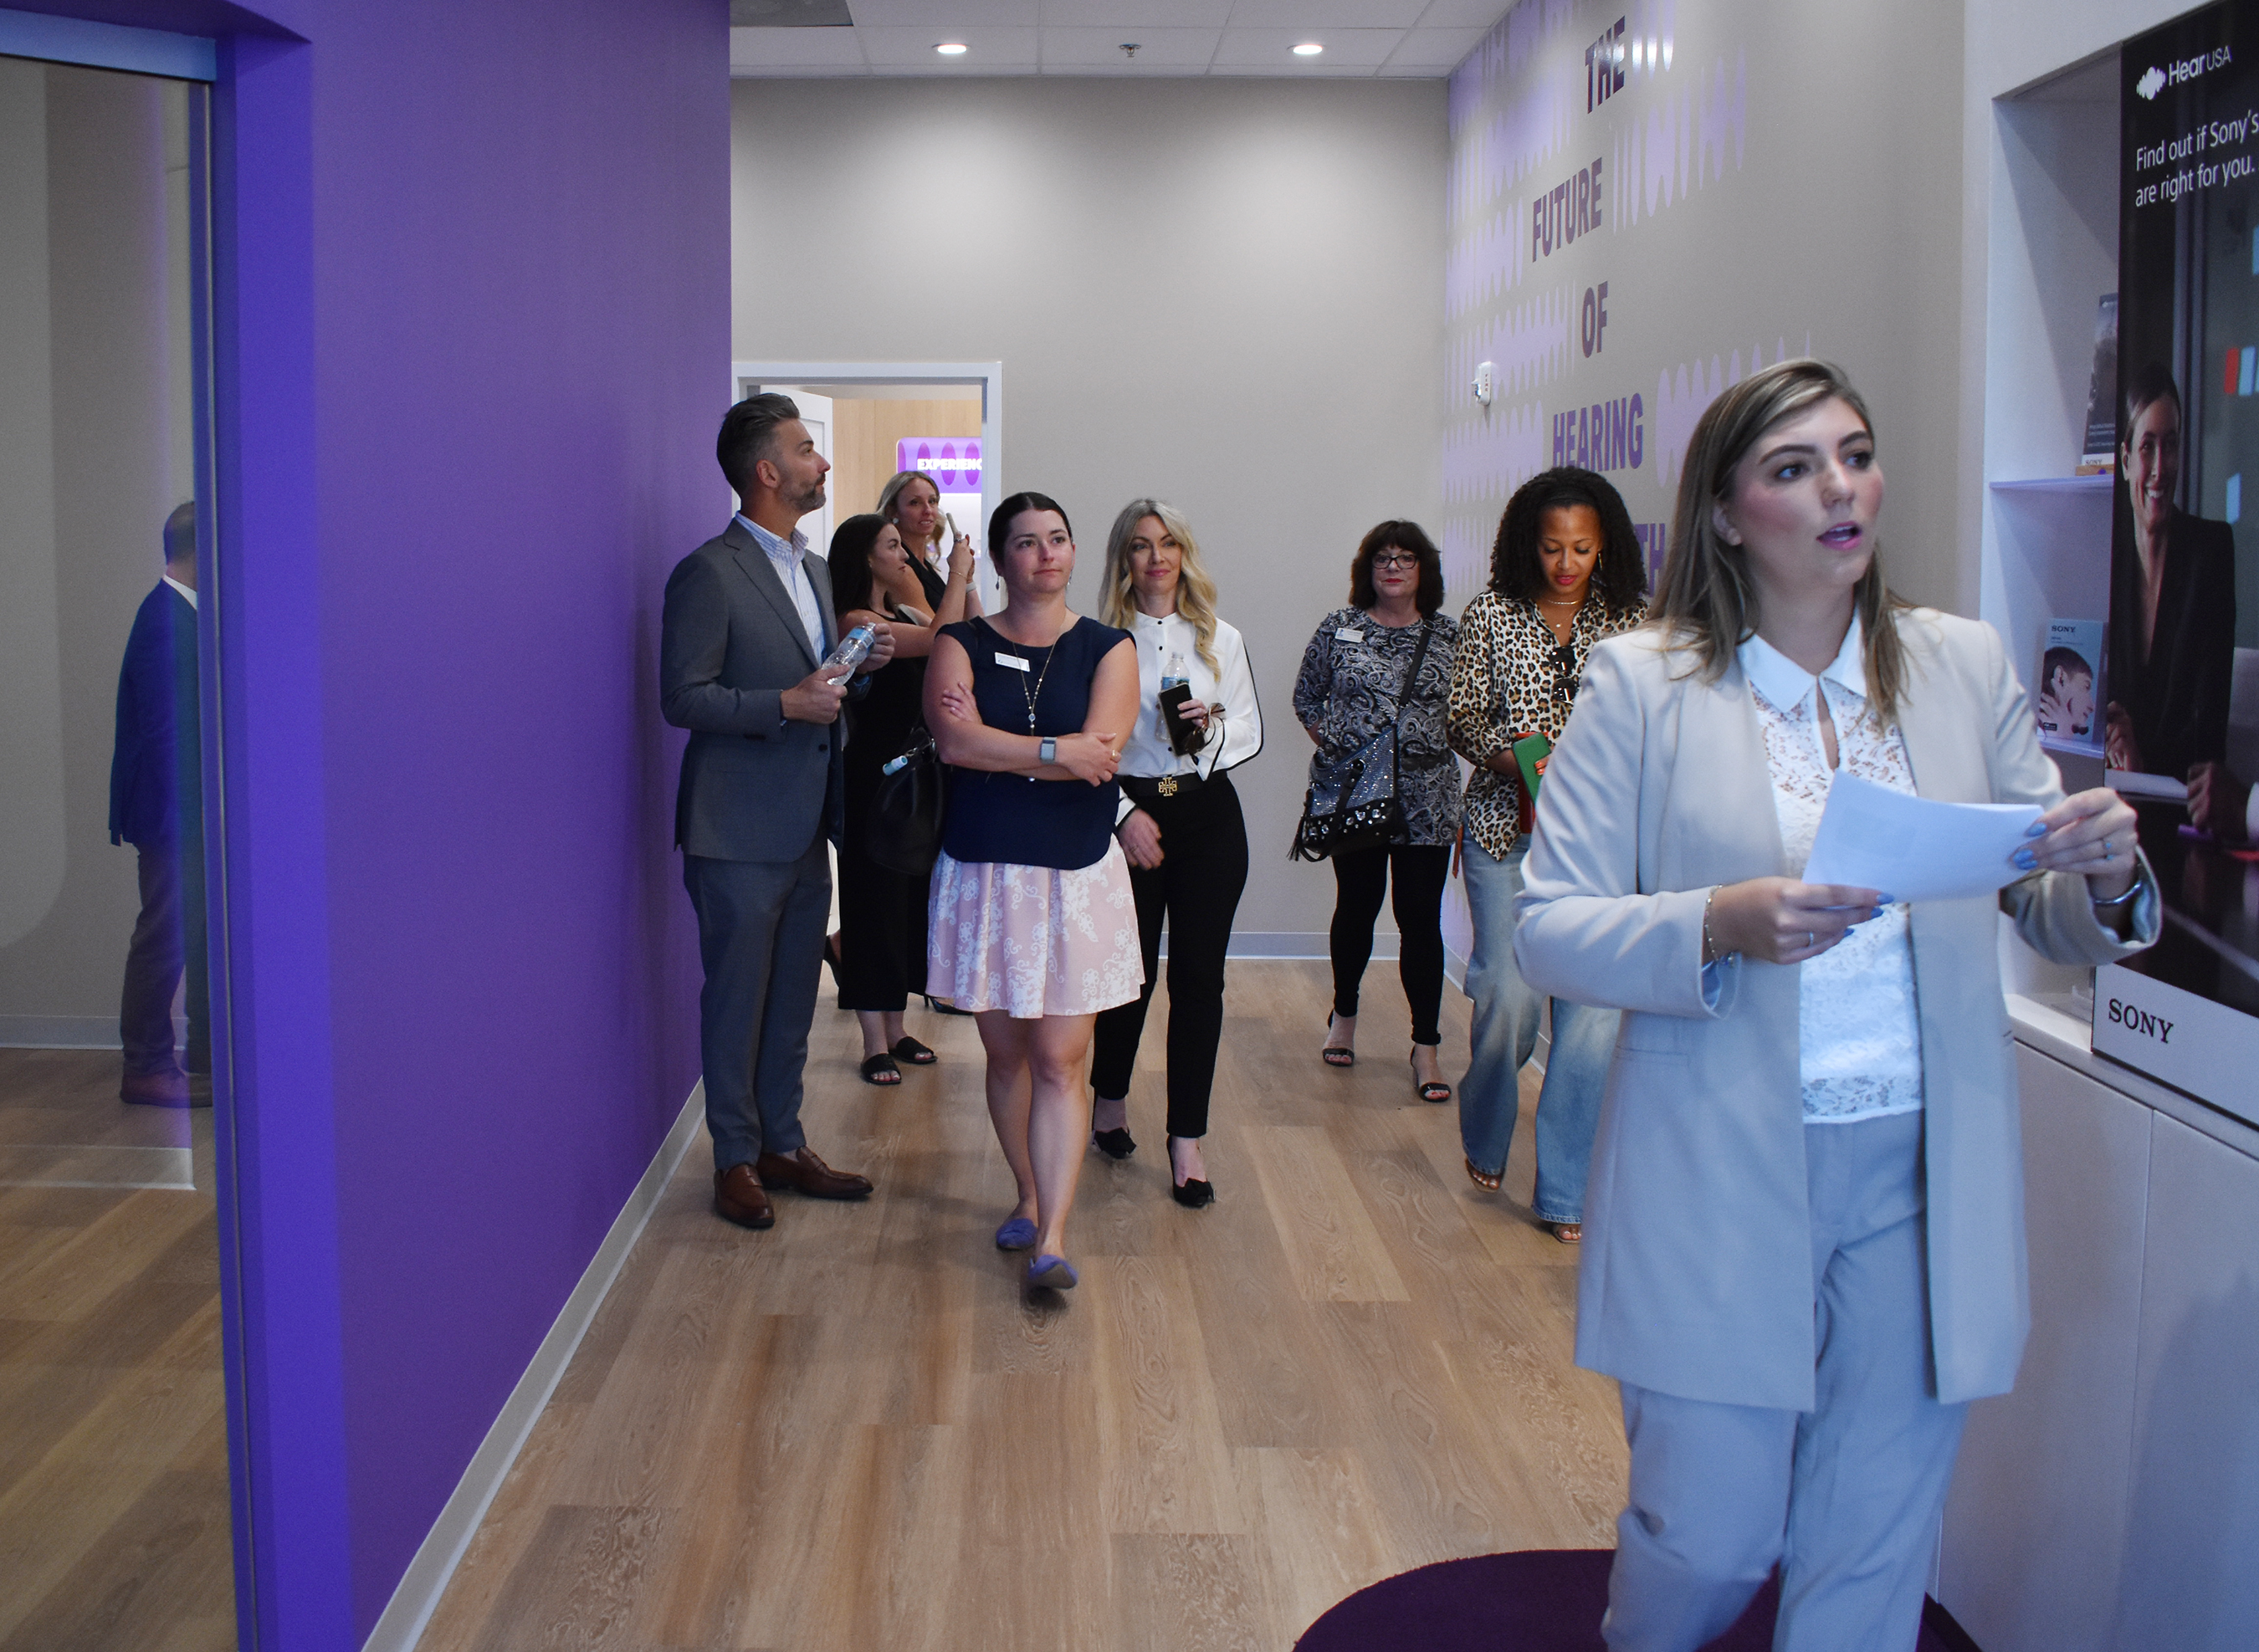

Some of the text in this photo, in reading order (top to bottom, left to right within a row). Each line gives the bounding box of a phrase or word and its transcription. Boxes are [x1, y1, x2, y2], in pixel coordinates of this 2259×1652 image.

[1585, 15, 1626, 115] THE
[2136, 110, 2259, 171] Find out if Sony's
[1532, 156, 1602, 263] FUTURE
[2135, 156, 2256, 207] are right for you.
[1581, 280, 1608, 359] OF
[1553, 392, 1643, 473] HEARING
[917, 458, 983, 471] EXPERIENC
[2051, 625, 2076, 633] SONY
[2108, 998, 2174, 1044] SONY
